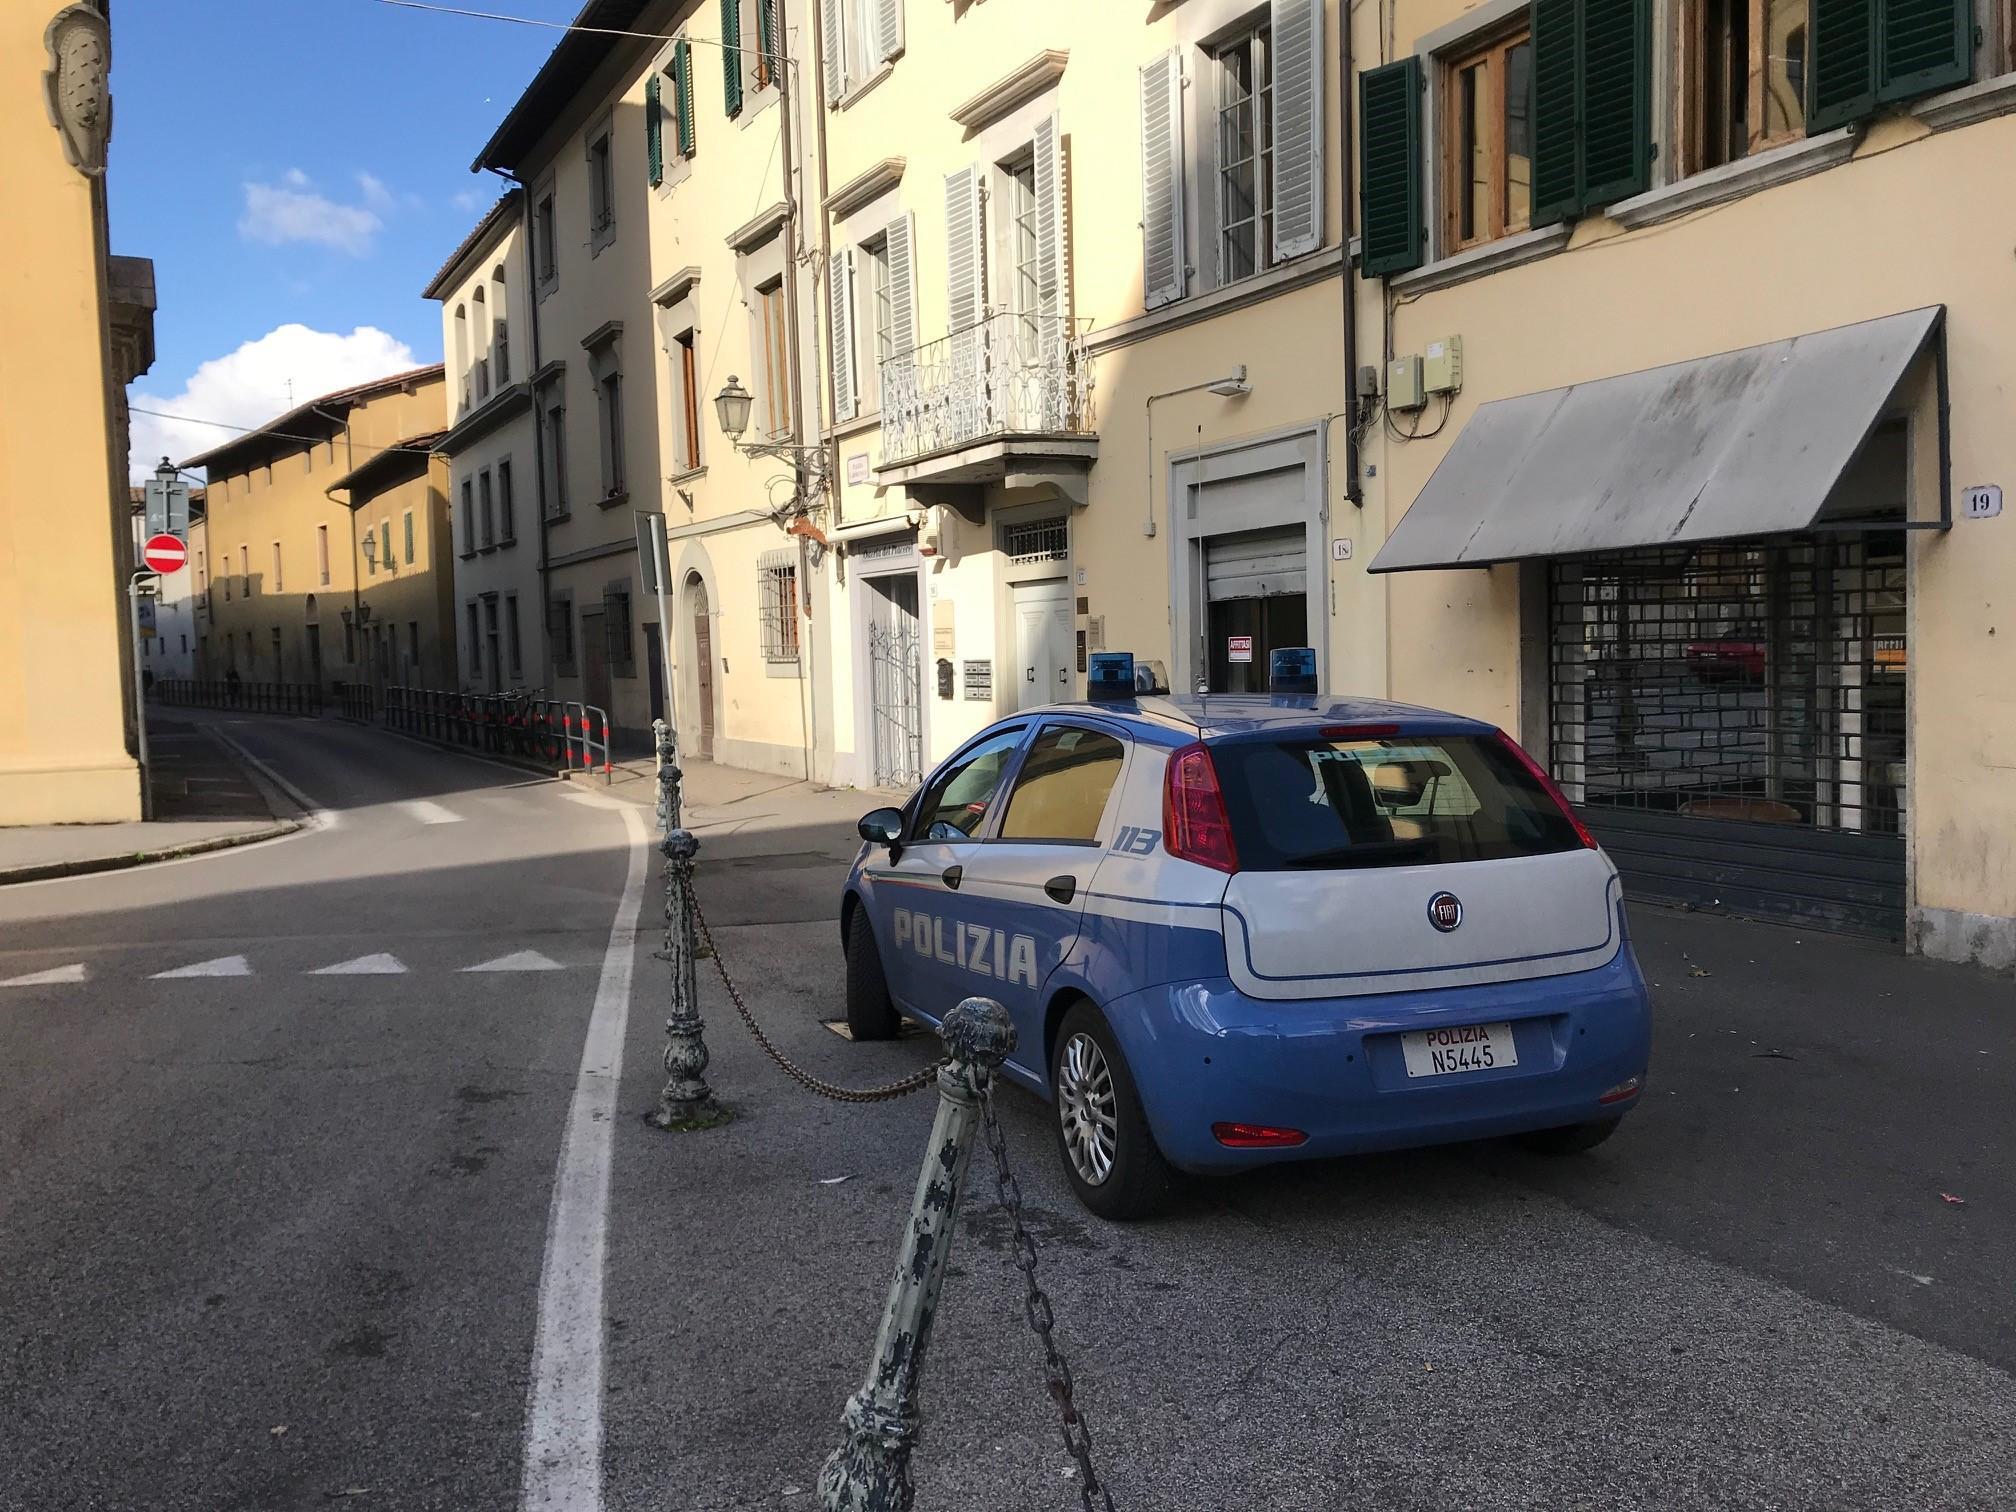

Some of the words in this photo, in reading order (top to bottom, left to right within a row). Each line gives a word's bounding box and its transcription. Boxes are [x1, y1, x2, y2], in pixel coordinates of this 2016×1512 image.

[1973, 494, 1989, 511] 19
[1111, 825, 1162, 856] 113
[1439, 904, 1456, 921] FIAT
[894, 907, 1038, 990] POLIZIA
[1426, 1026, 1490, 1047] POLIZIA
[1431, 1045, 1495, 1074] N5445
